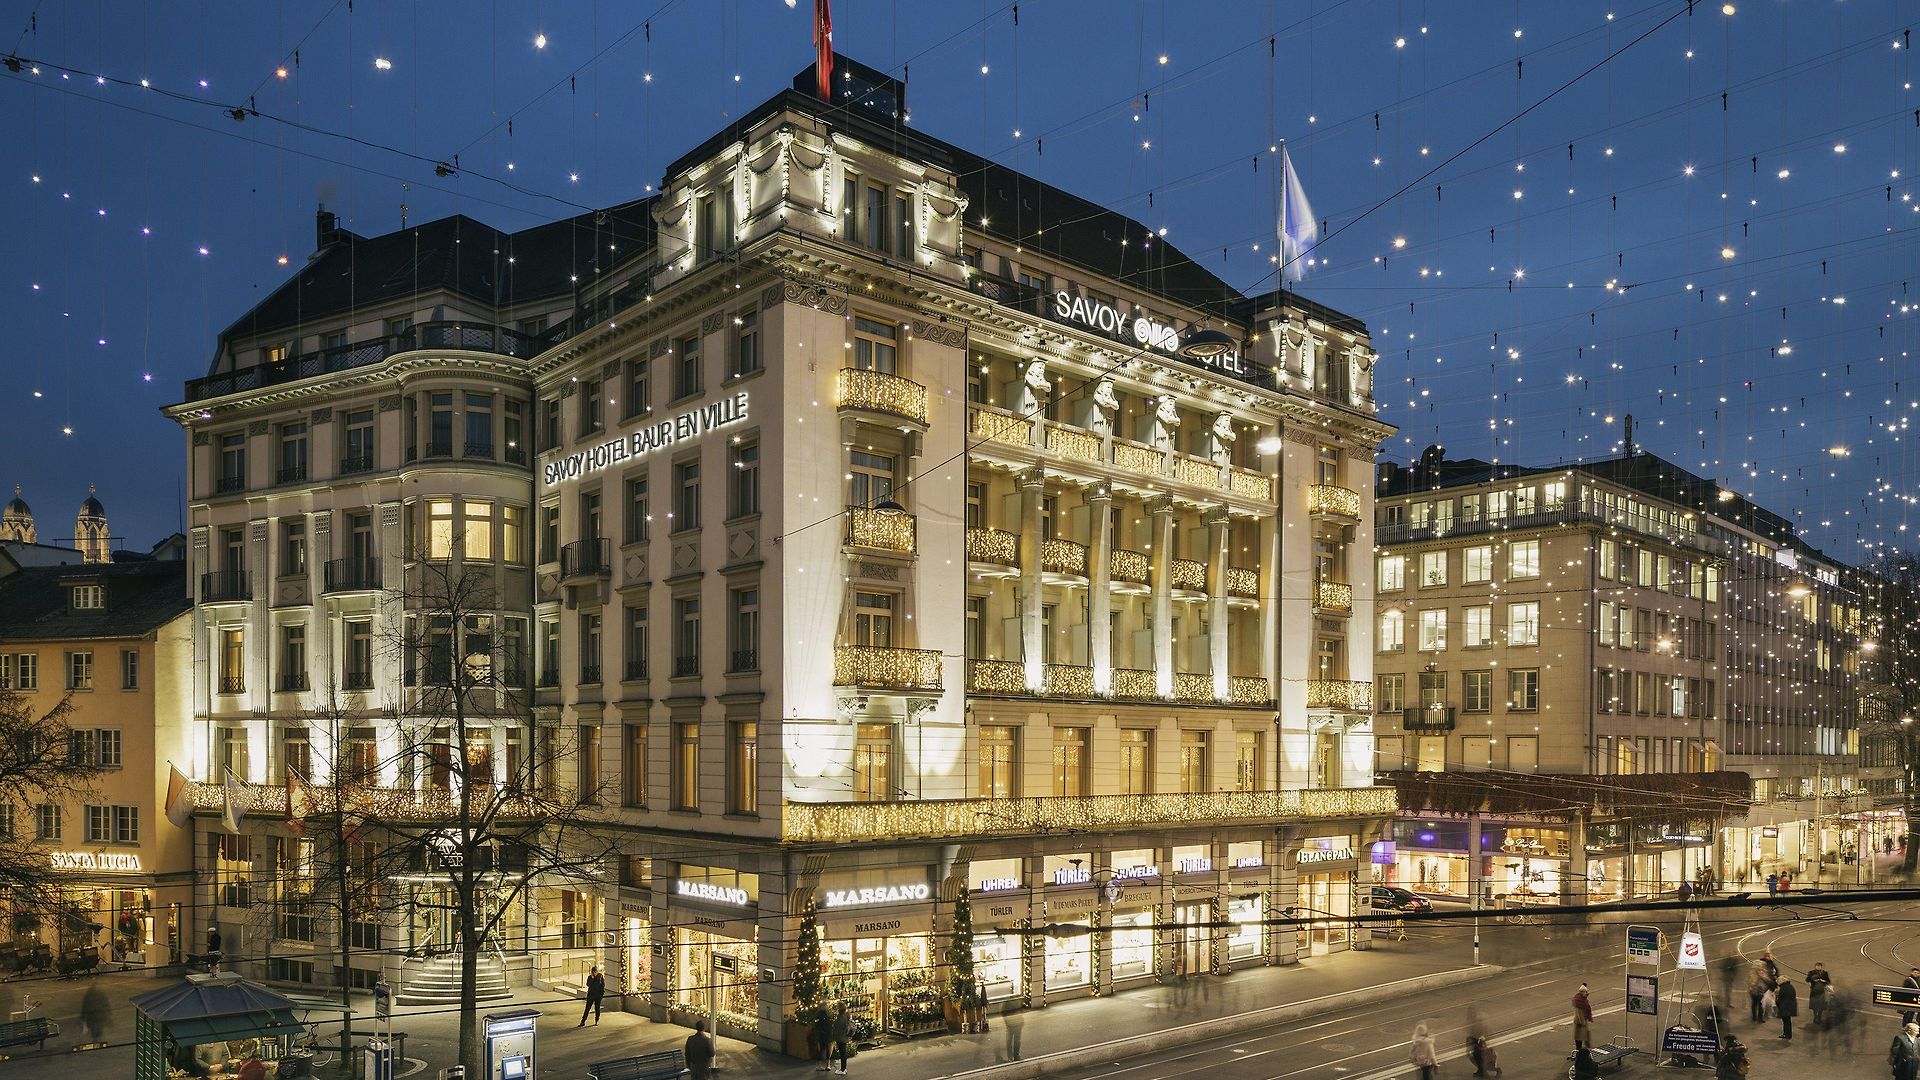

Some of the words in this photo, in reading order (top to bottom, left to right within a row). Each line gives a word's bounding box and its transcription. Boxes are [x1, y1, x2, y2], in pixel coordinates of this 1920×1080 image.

[1056, 290, 1128, 335] SAVOY
[544, 452, 585, 485] SAVOY
[587, 438, 629, 471] HOTEL
[632, 421, 672, 456] BAUR
[677, 411, 698, 440] EN
[701, 393, 747, 431] VILLE
[51, 852, 97, 869] SANTA
[98, 854, 142, 870] LUCIA
[1236, 857, 1263, 868] UHREN
[1299, 848, 1353, 864] BLANCPAIN
[1181, 858, 1212, 873] TÜRLER
[1055, 868, 1089, 885] TÜRLER
[1116, 866, 1158, 880] JUWELEN
[982, 878, 1018, 892] UHREN
[677, 880, 748, 905] MARSANO
[826, 884, 929, 907] MARSANO
[1124, 891, 1152, 903] BREGUET
[621, 902, 648, 915] MARSANO
[990, 906, 1013, 917] TÜRLER
[695, 916, 725, 929] MARSANO
[855, 919, 901, 932] MARSANO
[1672, 1042, 1695, 1051] Freude
